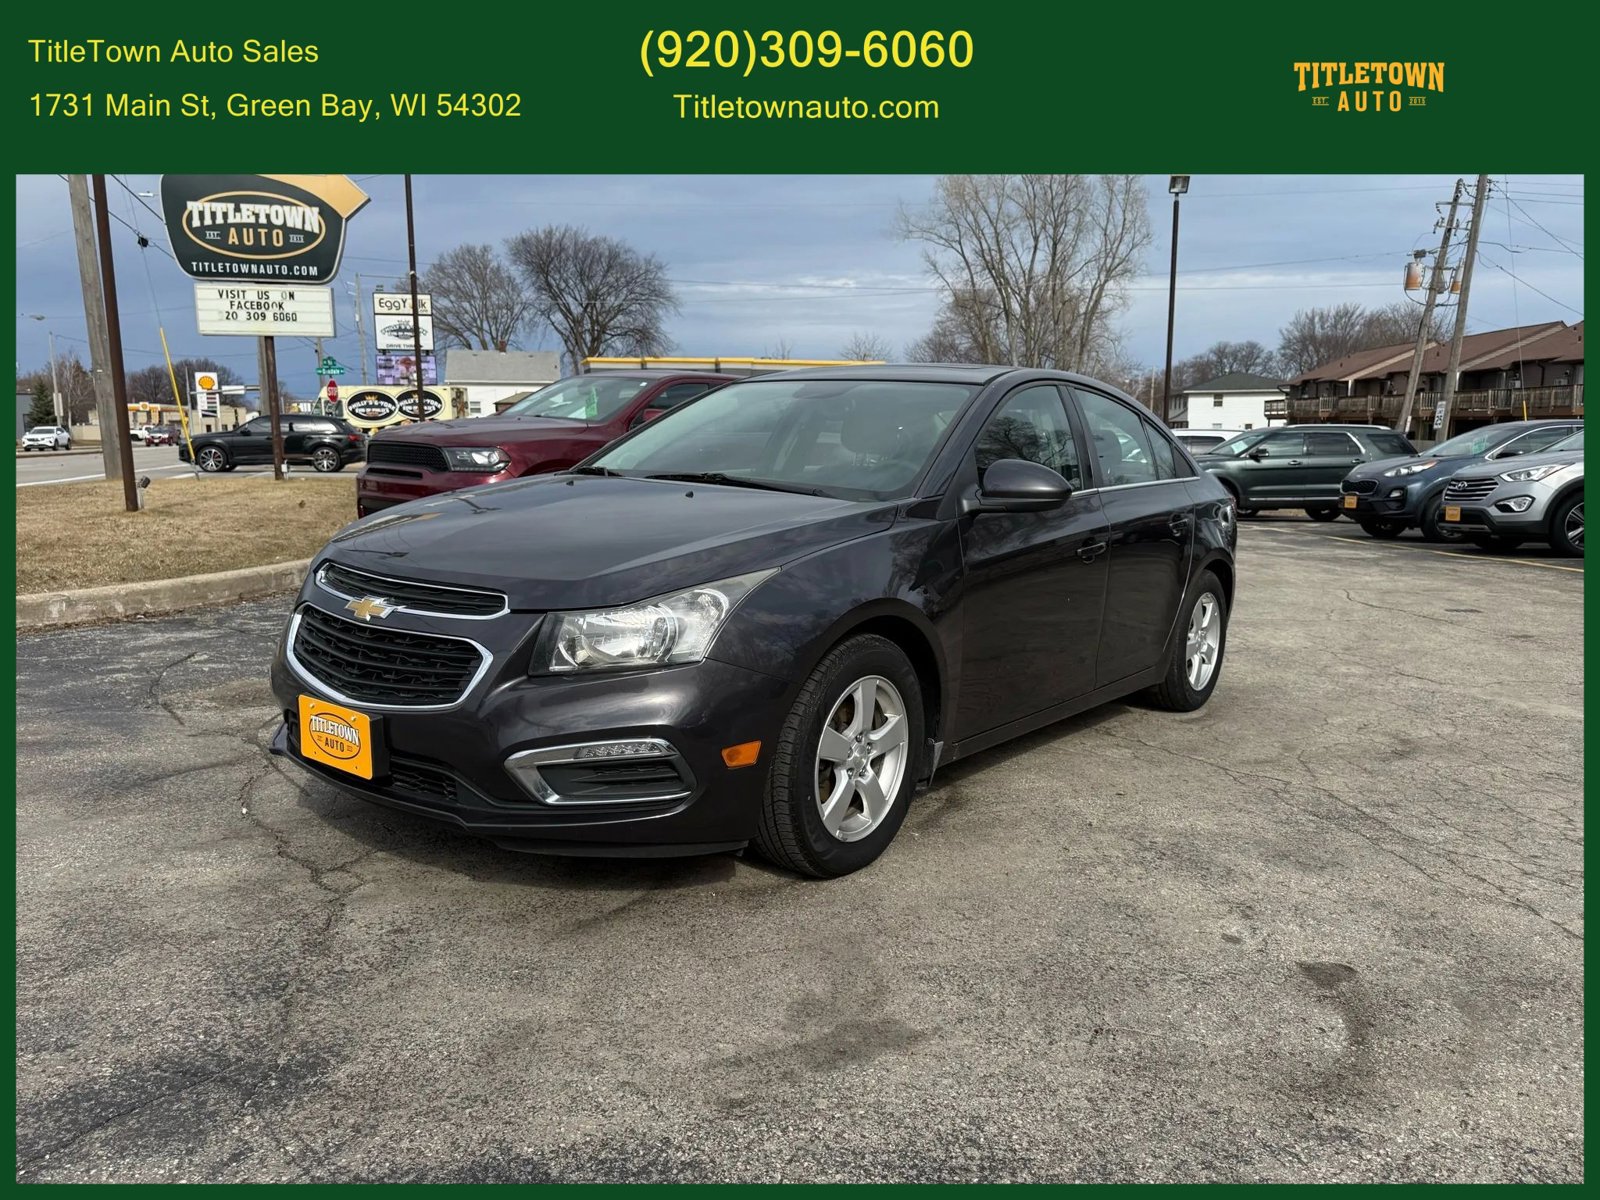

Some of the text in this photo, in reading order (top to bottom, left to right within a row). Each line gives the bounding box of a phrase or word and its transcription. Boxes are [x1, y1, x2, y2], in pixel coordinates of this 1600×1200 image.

[186, 201, 320, 234] TITLETOWN
[228, 227, 284, 247] AUTO
[191, 262, 318, 276] TITLETOWNAUTO.COM
[218, 289, 295, 300] VISIT US ON
[230, 301, 285, 311] FACEBOOK
[378, 298, 427, 311] EggYlk
[246, 311, 267, 321] 309
[273, 312, 297, 322] 6060
[311, 716, 359, 746] TITLETOWN
[325, 738, 345, 752] AUTO
